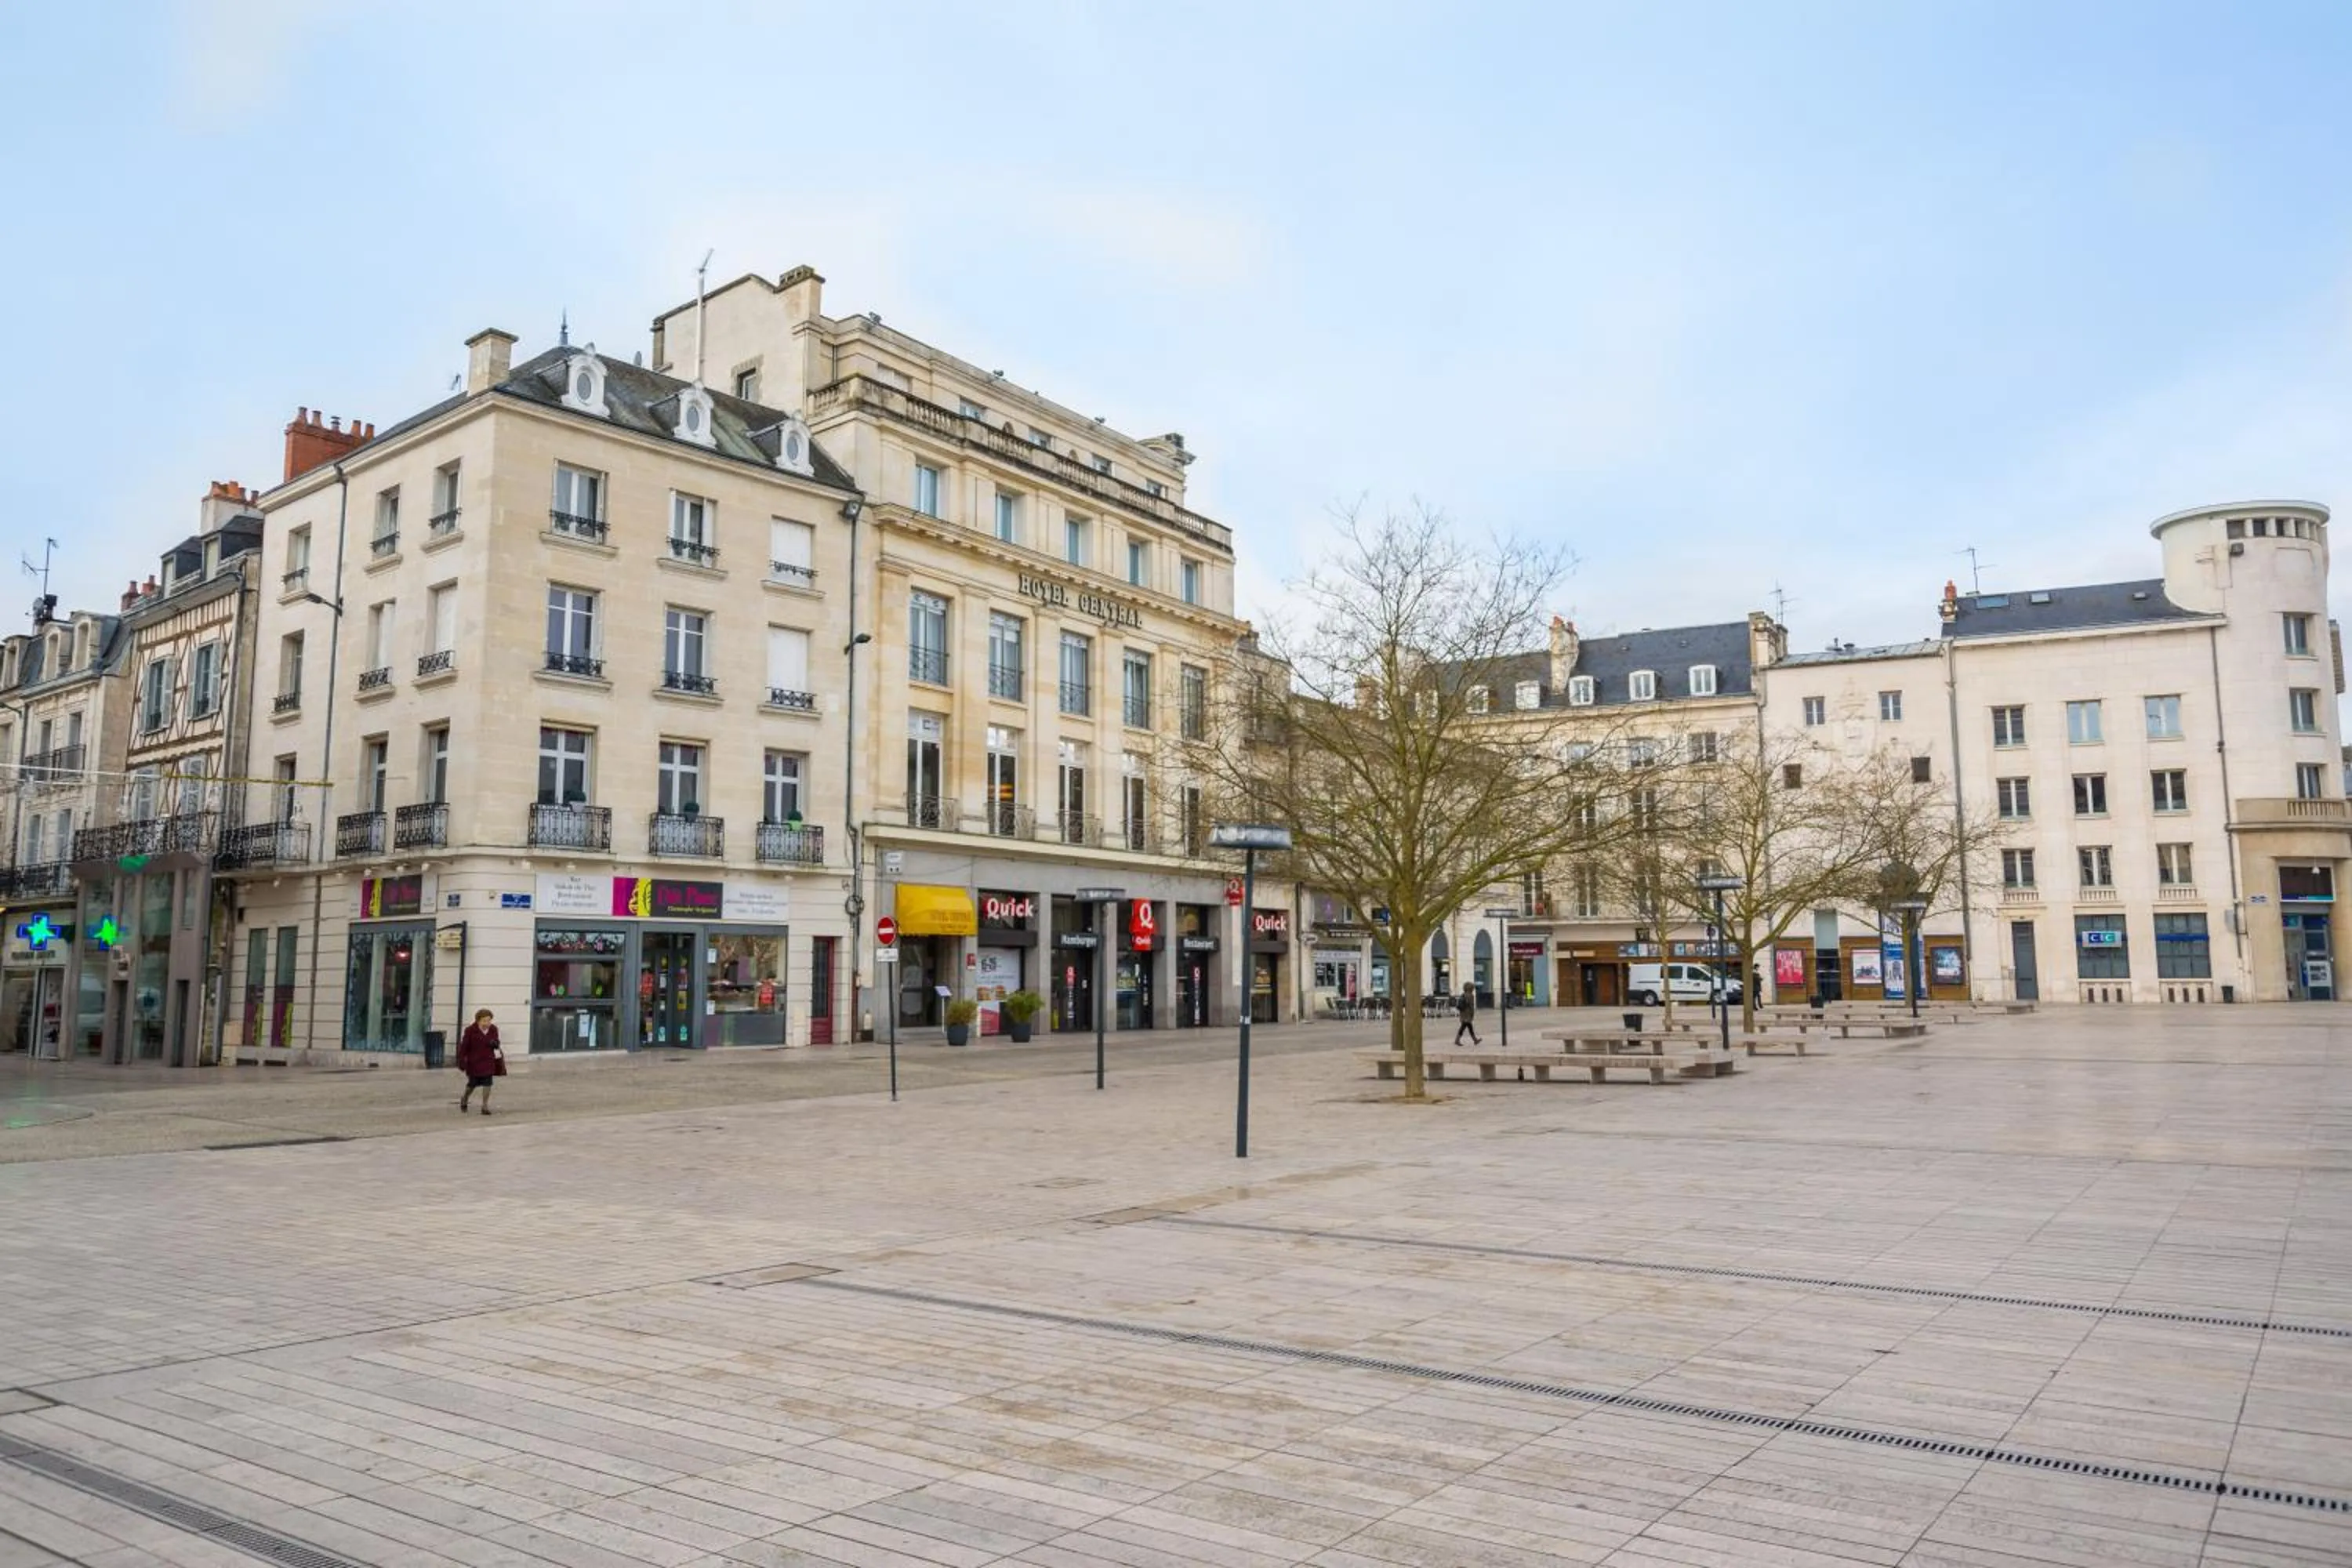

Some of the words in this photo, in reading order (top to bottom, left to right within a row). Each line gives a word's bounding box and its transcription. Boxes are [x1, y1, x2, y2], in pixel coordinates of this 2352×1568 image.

[1019, 574, 1069, 608] HOTEL
[1079, 594, 1142, 629] CENTRAL
[987, 898, 1034, 919] Quick
[1139, 903, 1152, 929] Q
[1255, 915, 1287, 932] Quick
[1183, 938, 1214, 950] Restaurant
